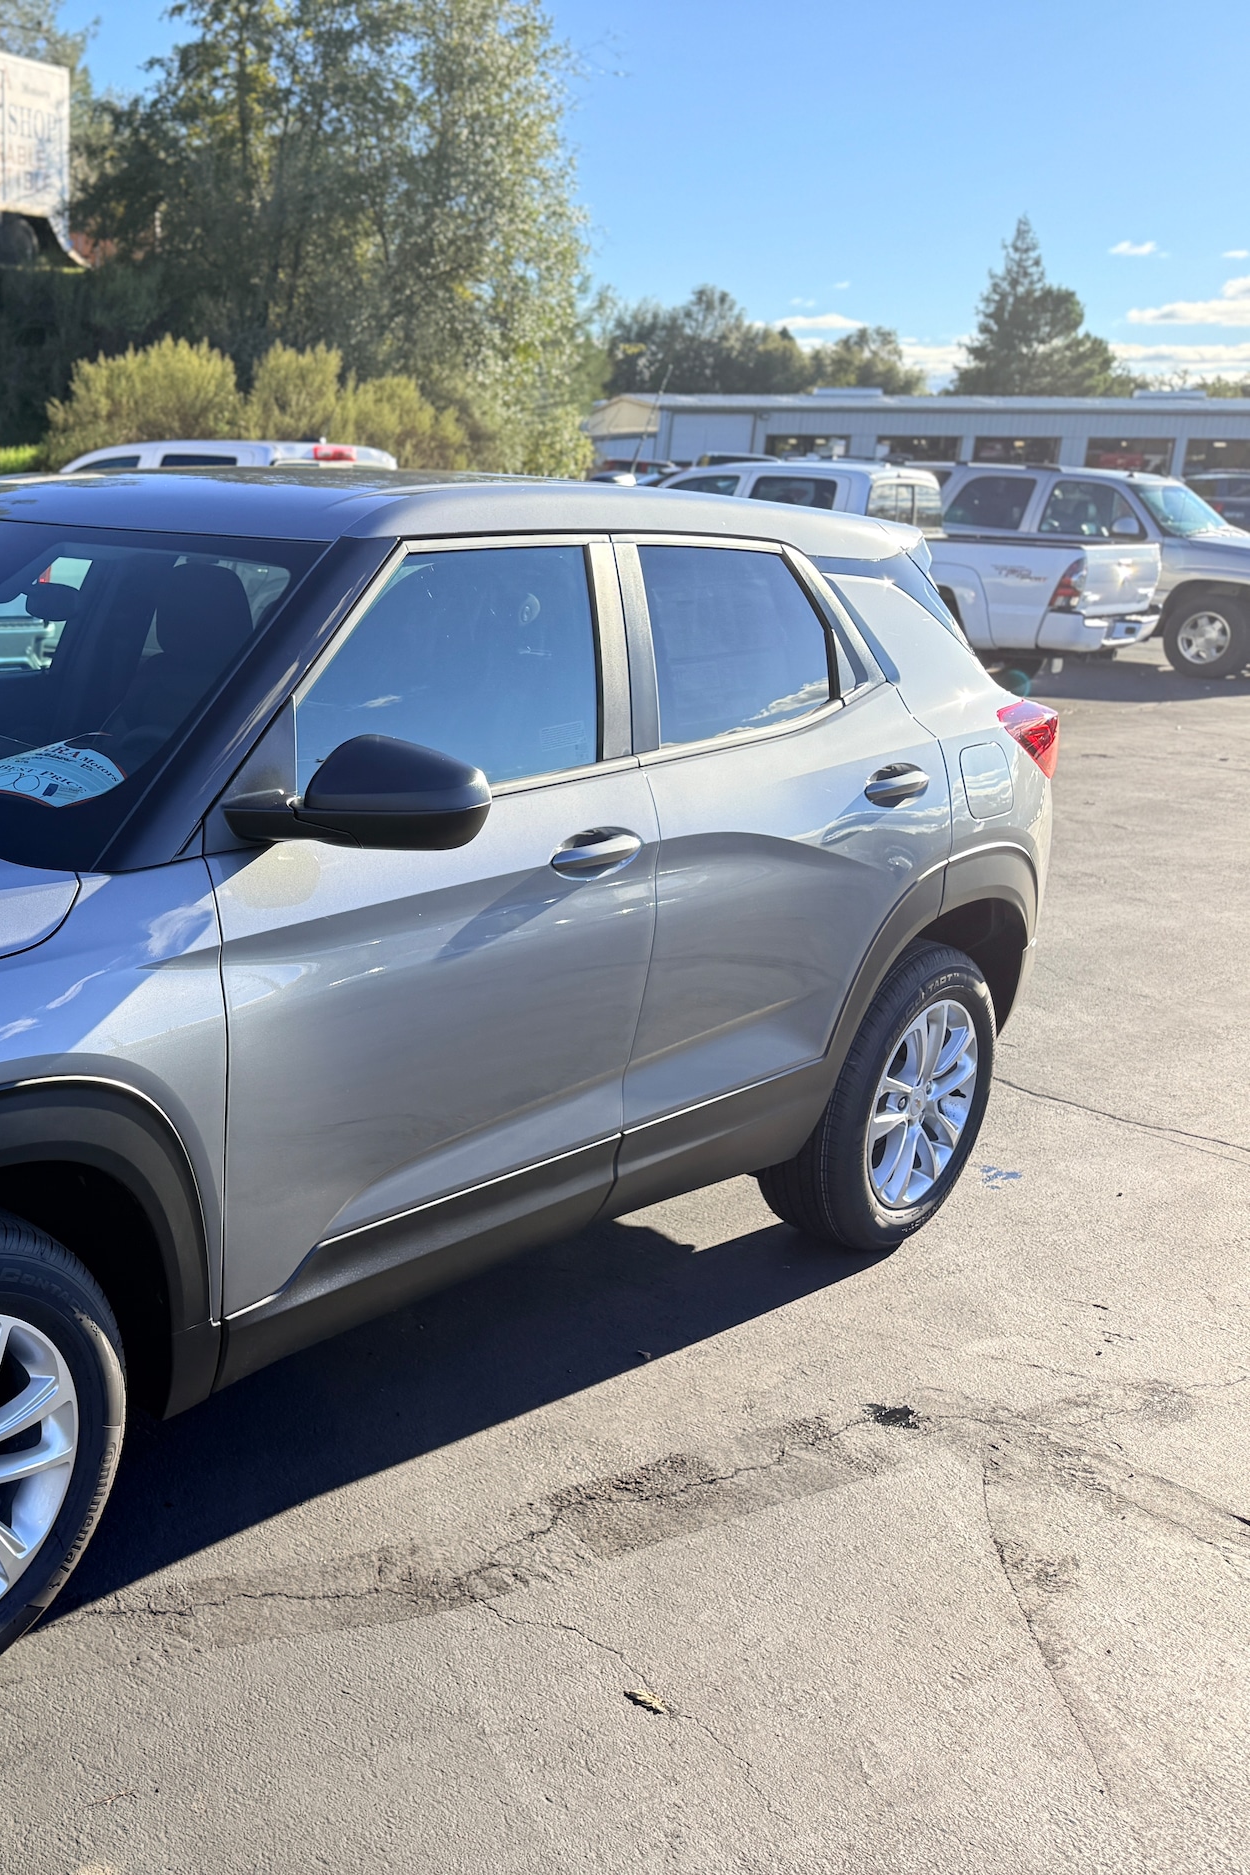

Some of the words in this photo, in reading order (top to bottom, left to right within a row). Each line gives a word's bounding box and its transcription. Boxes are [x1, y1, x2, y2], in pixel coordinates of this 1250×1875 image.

[8, 103, 56, 143] SHOP
[80, 757, 120, 783] Motors
[59, 1442, 117, 1573] Continental
